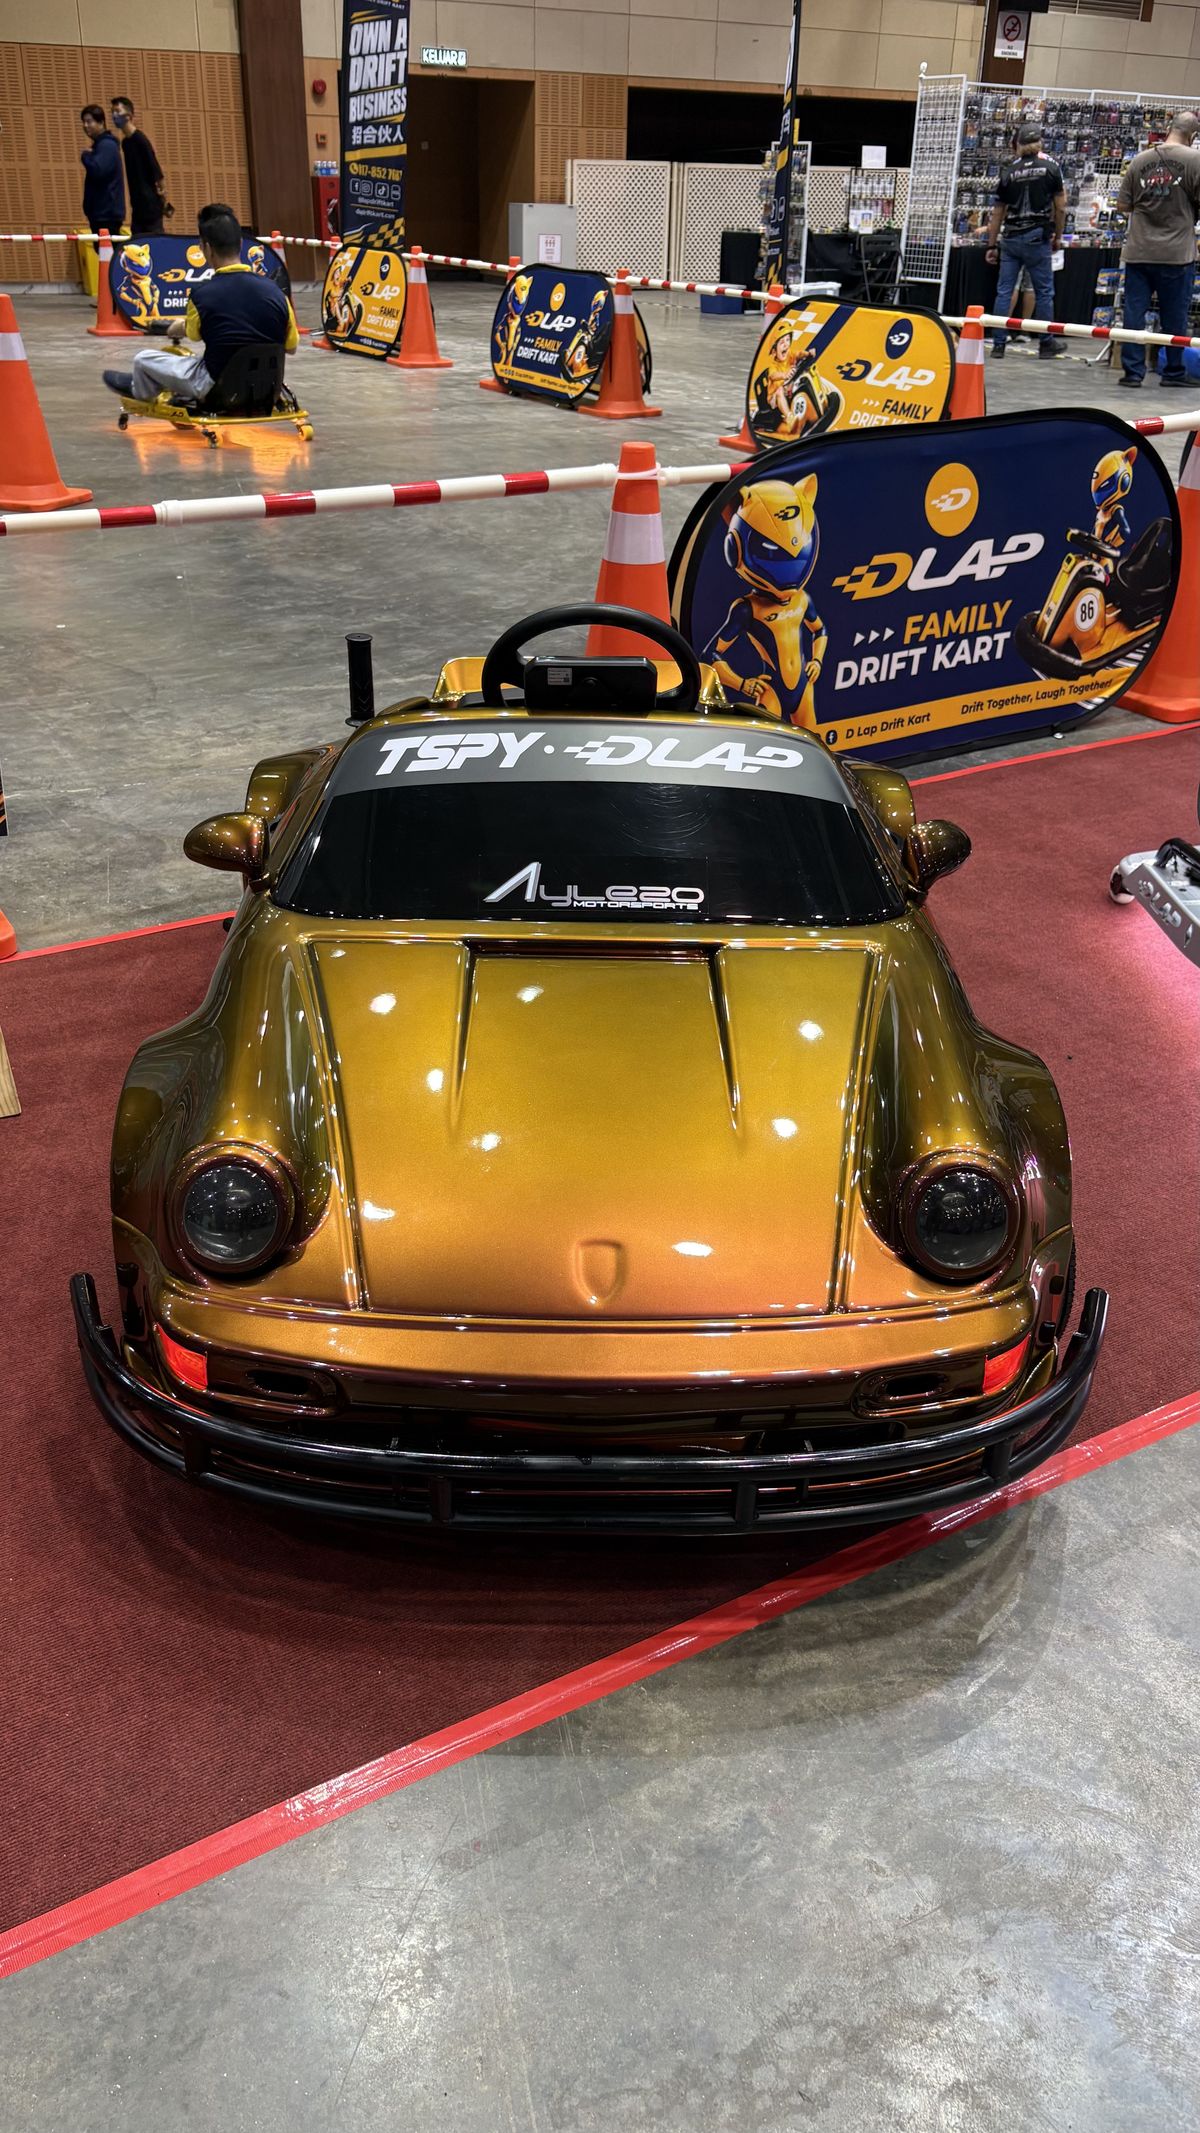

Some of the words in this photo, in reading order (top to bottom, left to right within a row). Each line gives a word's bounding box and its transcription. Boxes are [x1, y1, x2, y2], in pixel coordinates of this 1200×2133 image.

[349, 20, 392, 57] OWN
[394, 18, 407, 51] A
[422, 48, 458, 66] KELUAR
[349, 50, 407, 93] DRIFT
[349, 86, 407, 123] BUSINESS
[351, 124, 404, 145] 招合伙人
[158, 268, 215, 283] DLA
[163, 297, 188, 308] DRIF
[361, 282, 400, 302] DLAP
[380, 305, 400, 318] FAMILY
[524, 310, 577, 332] DLAP
[516, 346, 539, 361] DRIFT
[538, 350, 560, 366] KART
[534, 337, 563, 353] FAMILY
[836, 359, 936, 391] DLAP
[795, 401, 805, 416] 86
[848, 410, 890, 428] DRIFT
[881, 399, 933, 421] FAMILY
[831, 532, 1045, 601] DLAP
[1080, 600, 1094, 622] 86
[903, 600, 1012, 645] FAMILY
[834, 647, 927, 691] DRIFT
[932, 632, 1012, 672] KART
[960, 701, 984, 715] Drift
[986, 692, 1034, 712] Together,
[1035, 687, 1065, 703] Laugh
[1067, 679, 1112, 698] Together!
[845, 727, 854, 739] D
[857, 725, 878, 740] Lap
[880, 718, 905, 733] Drift
[907, 712, 931, 726] Kart
[375, 732, 546, 776] TSPY
[563, 735, 804, 774] DLAP
[573, 901, 699, 910] MOTORSPORTS
